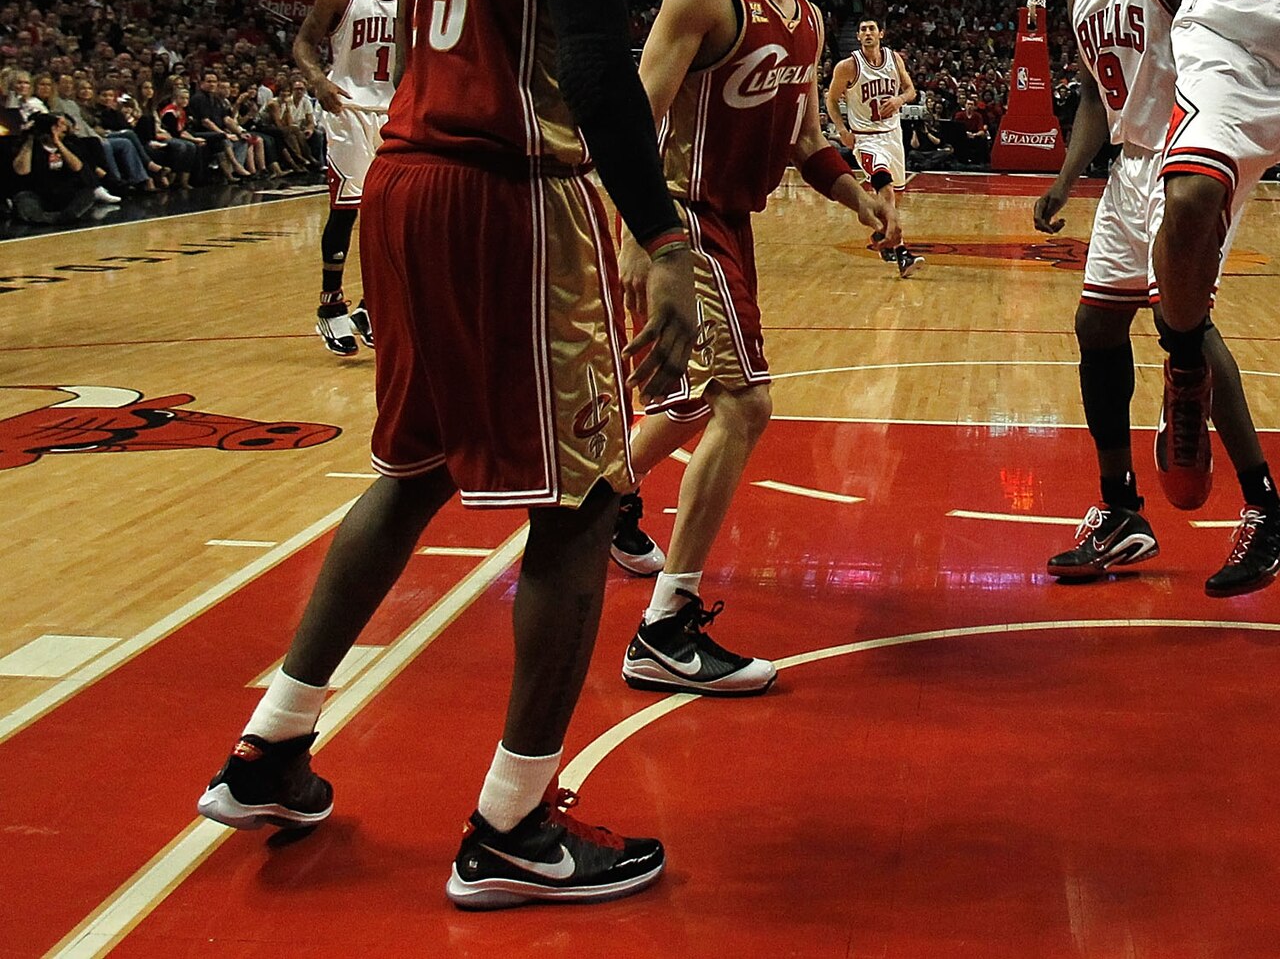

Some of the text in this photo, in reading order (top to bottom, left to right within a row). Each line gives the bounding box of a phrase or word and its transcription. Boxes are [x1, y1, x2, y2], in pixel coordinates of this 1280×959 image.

[373, 46, 390, 82] 1
[861, 78, 896, 104] BULLS
[1097, 51, 1129, 111] 9
[1007, 133, 1056, 146] PLAYOFFS
